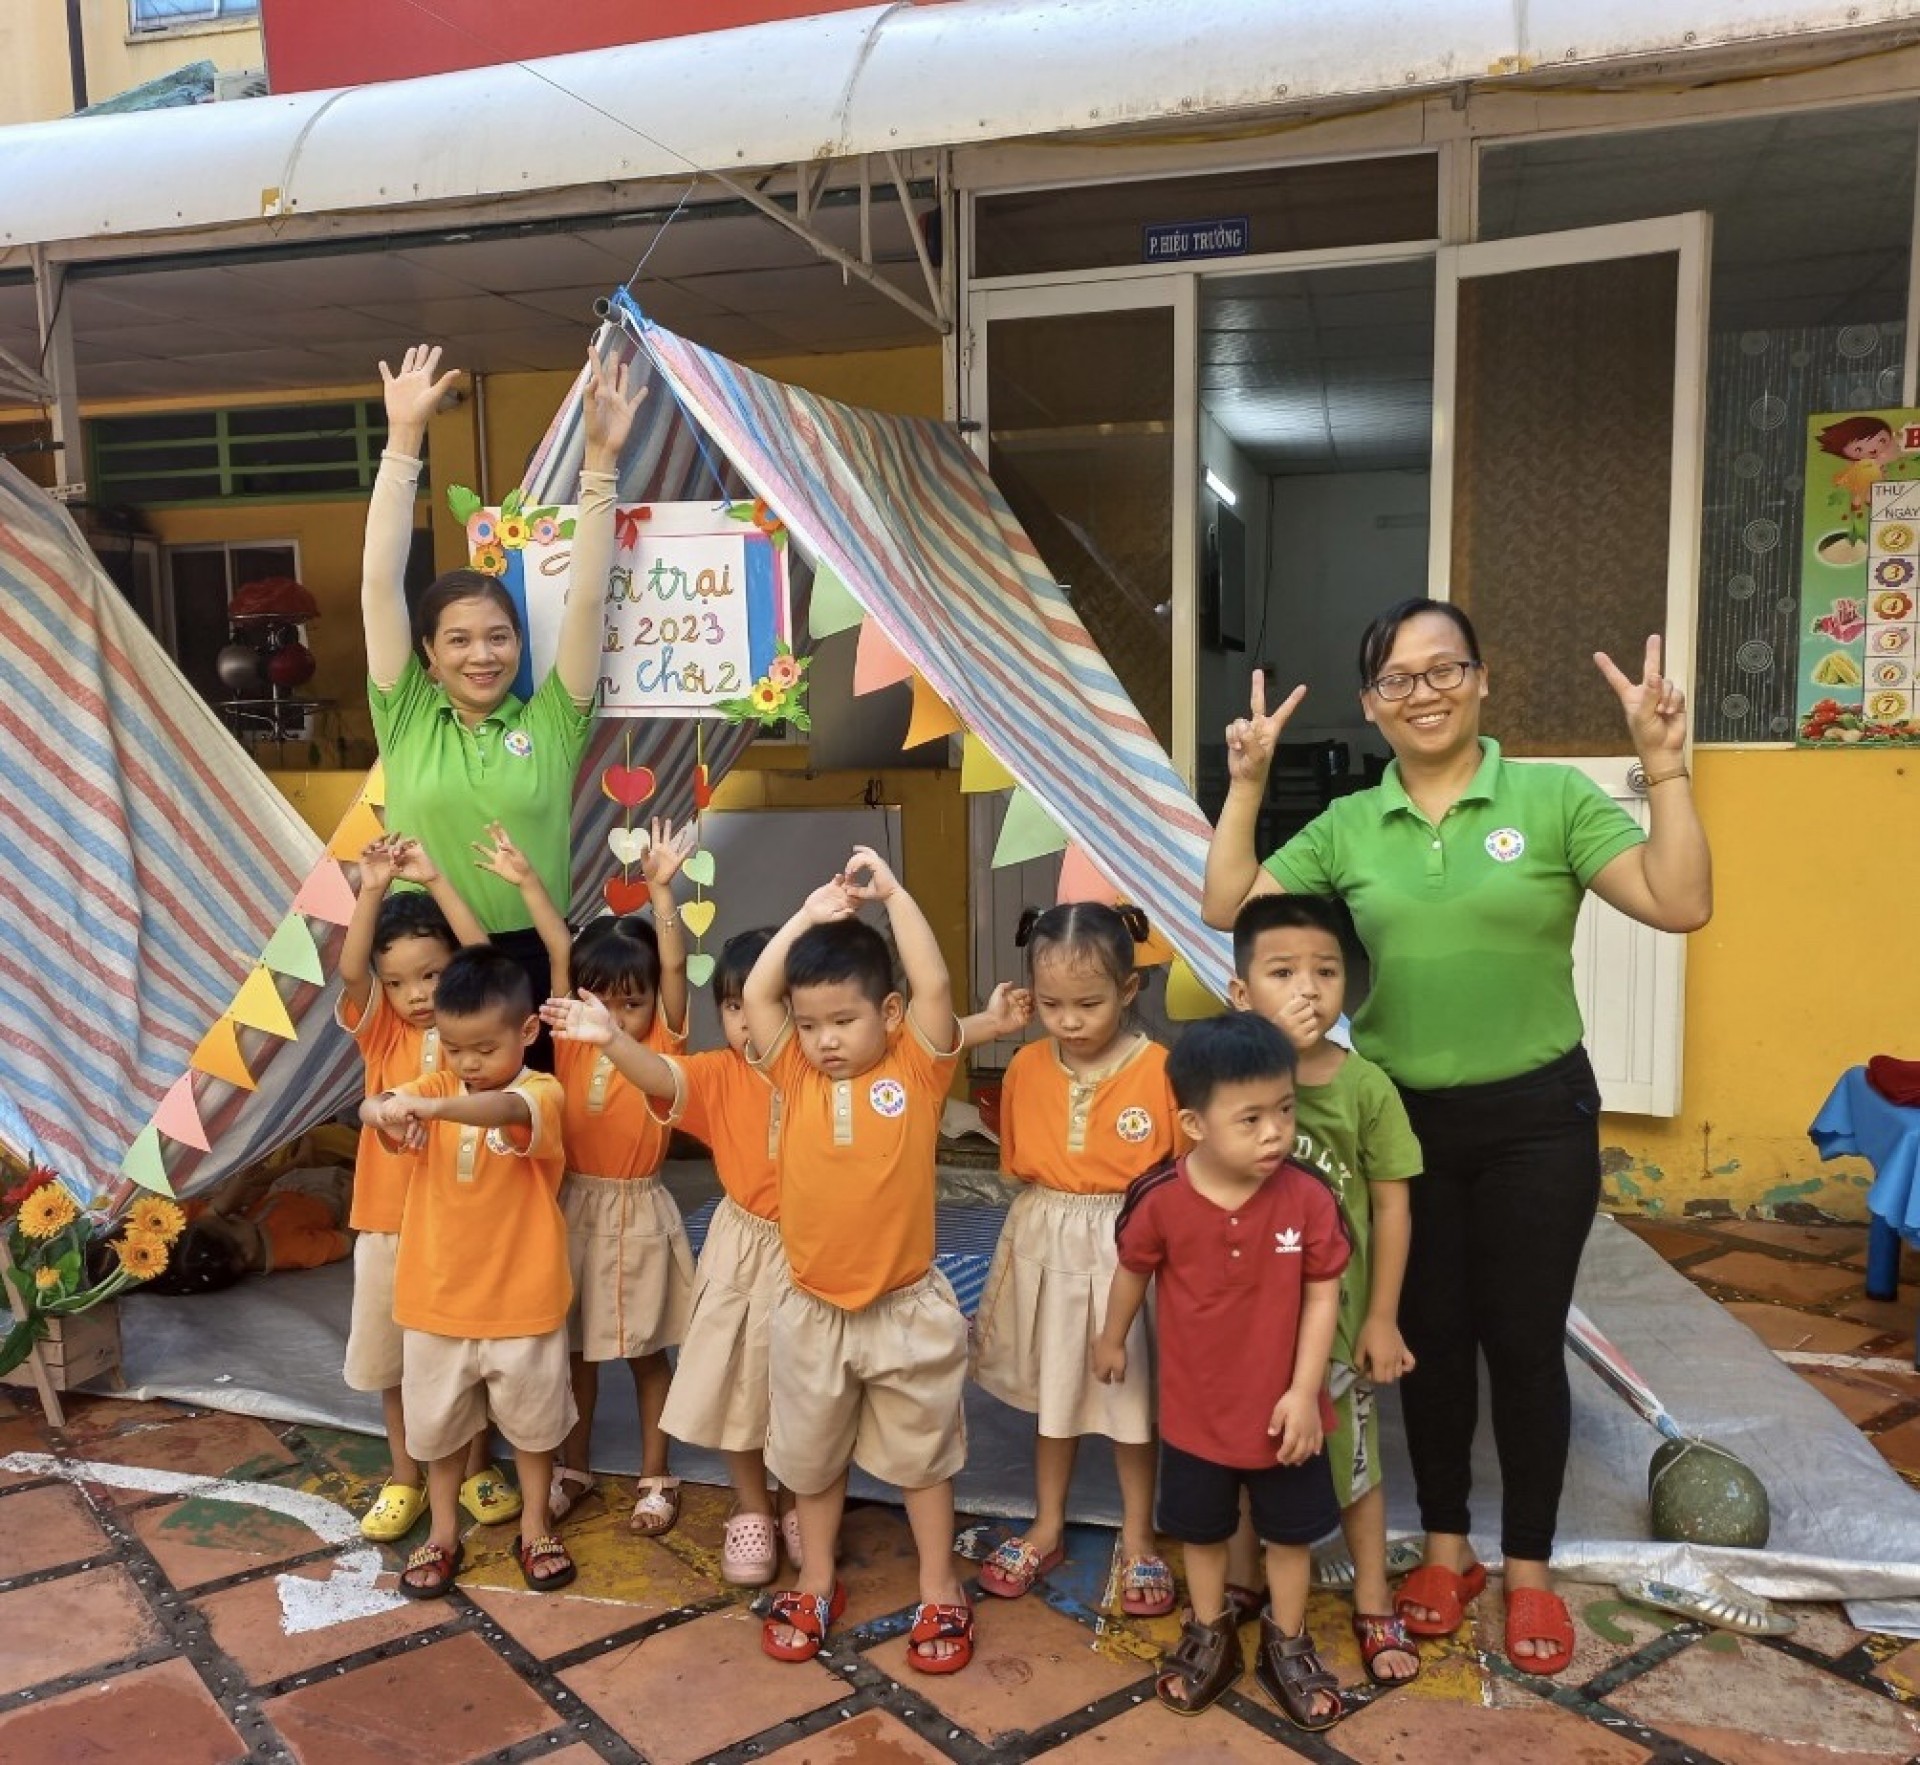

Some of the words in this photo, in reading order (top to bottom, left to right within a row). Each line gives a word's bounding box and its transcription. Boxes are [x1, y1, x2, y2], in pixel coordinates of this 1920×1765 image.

[1192, 224, 1242, 251] TRƯỞNG
[648, 558, 734, 605] trại
[634, 612, 726, 646] 2023
[714, 661, 742, 693] 2
